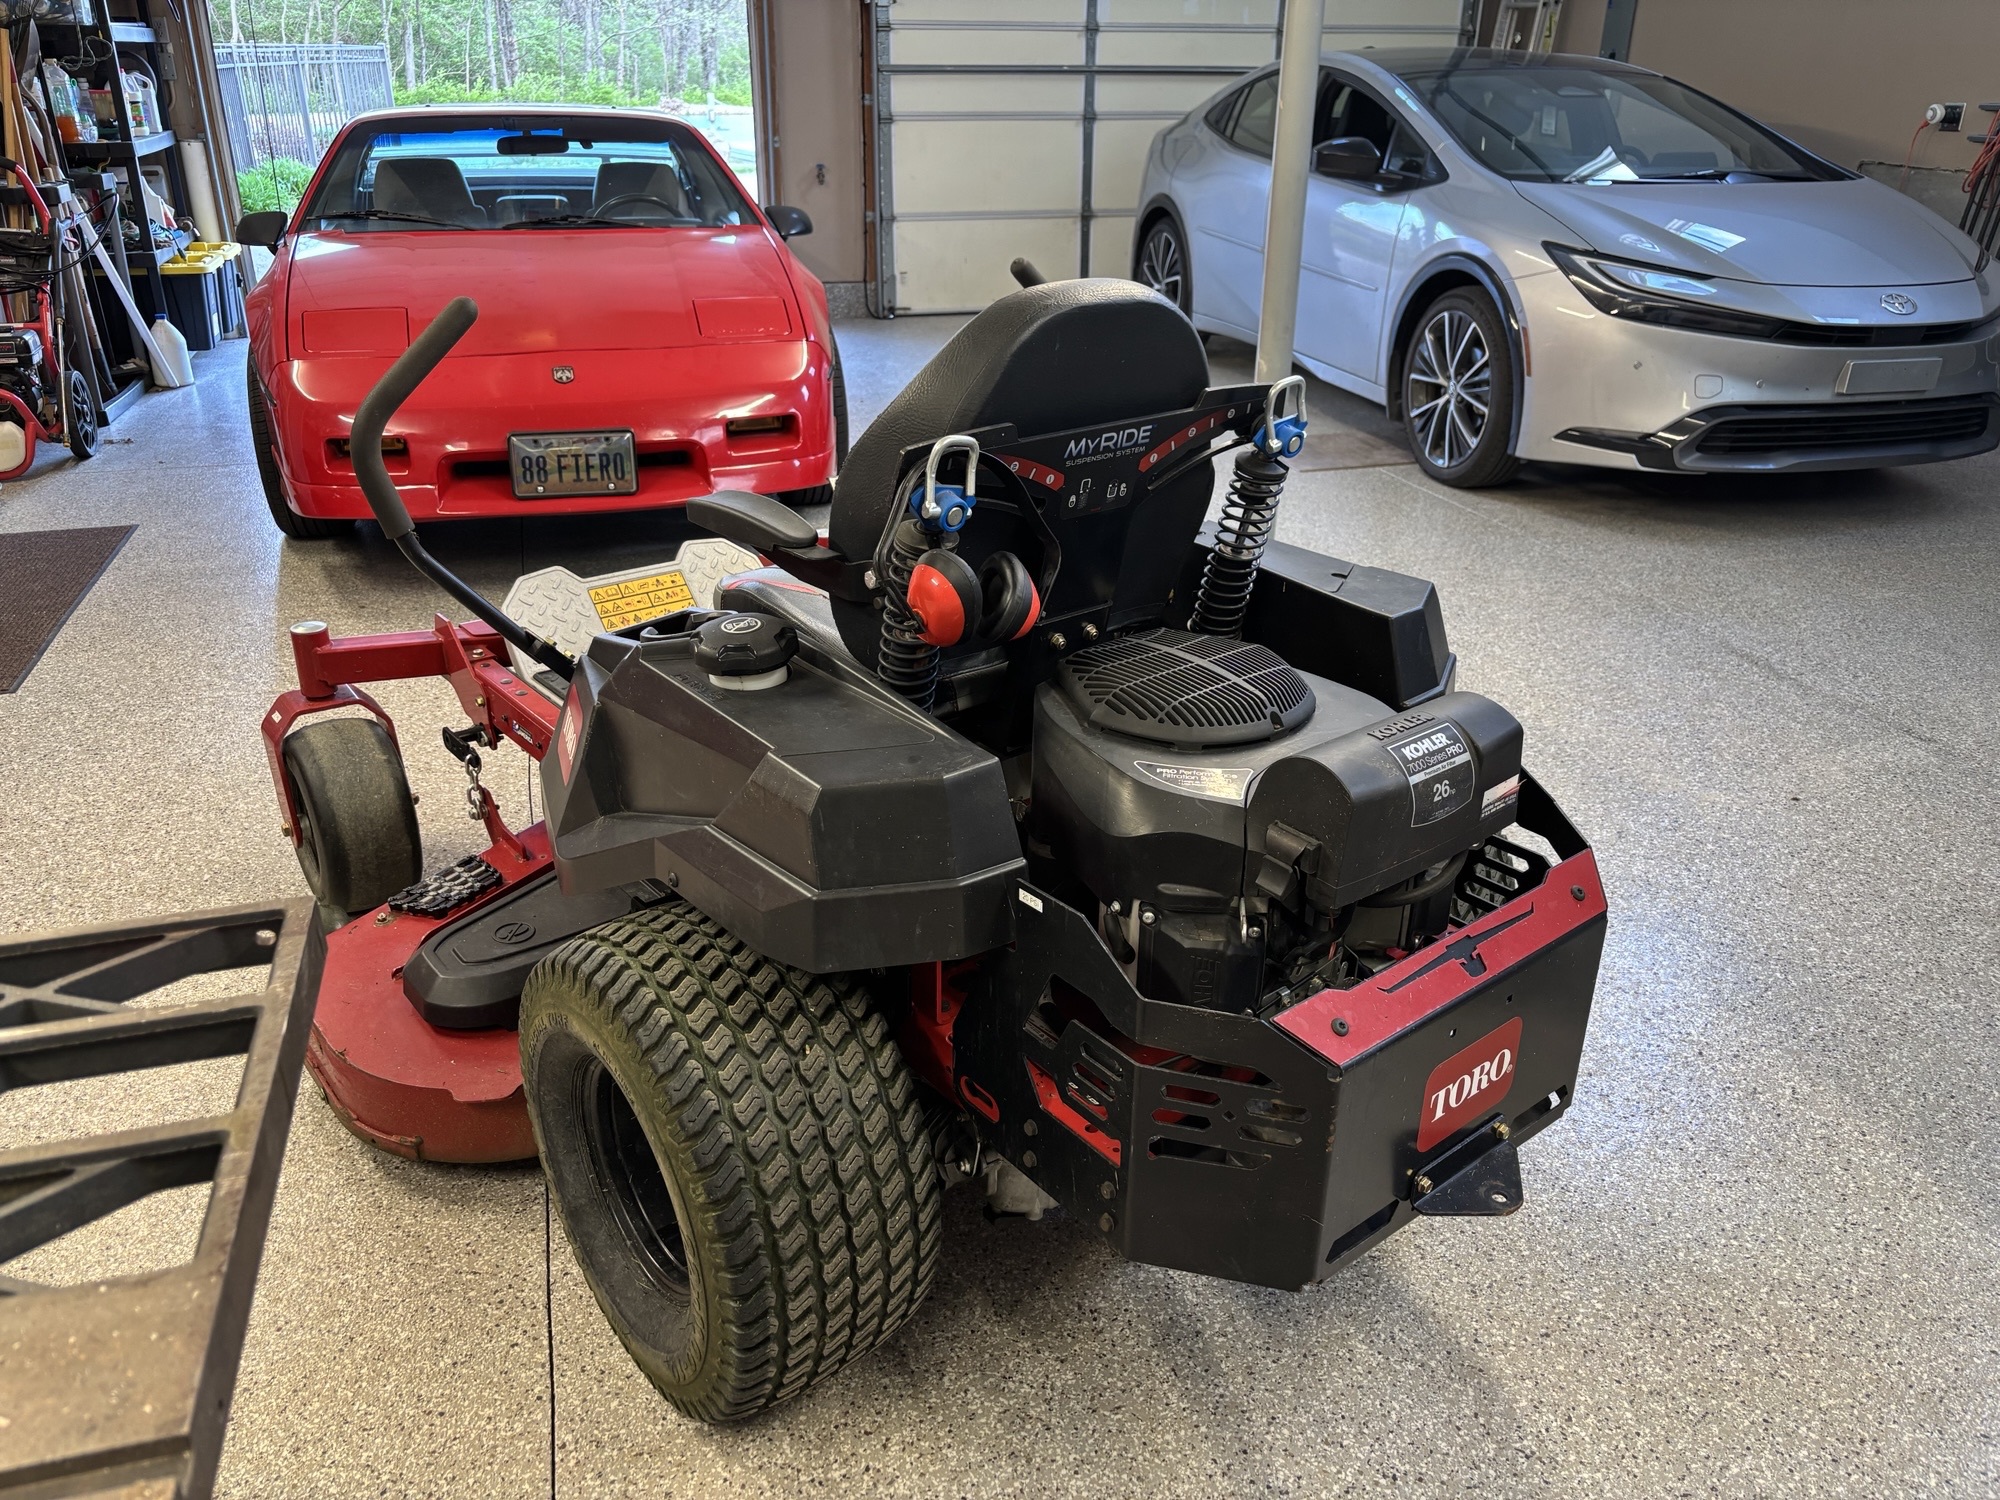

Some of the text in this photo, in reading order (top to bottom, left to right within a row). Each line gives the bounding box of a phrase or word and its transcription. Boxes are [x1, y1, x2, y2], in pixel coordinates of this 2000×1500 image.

[521, 452, 626, 484] 88 FIERO
[1066, 446, 1146, 467] SUSPENSION SYSTEM
[1367, 714, 1435, 741] KOHLER
[1401, 733, 1450, 760] KOHLER
[1407, 743, 1464, 774] 7000 Series PRO
[1179, 769, 1238, 779] Performnce
[1200, 775, 1232, 783] Sysm
[1424, 759, 1457, 777] Premium Air Filter
[1433, 780, 1450, 802] 26
[1430, 1048, 1511, 1123] TORO
